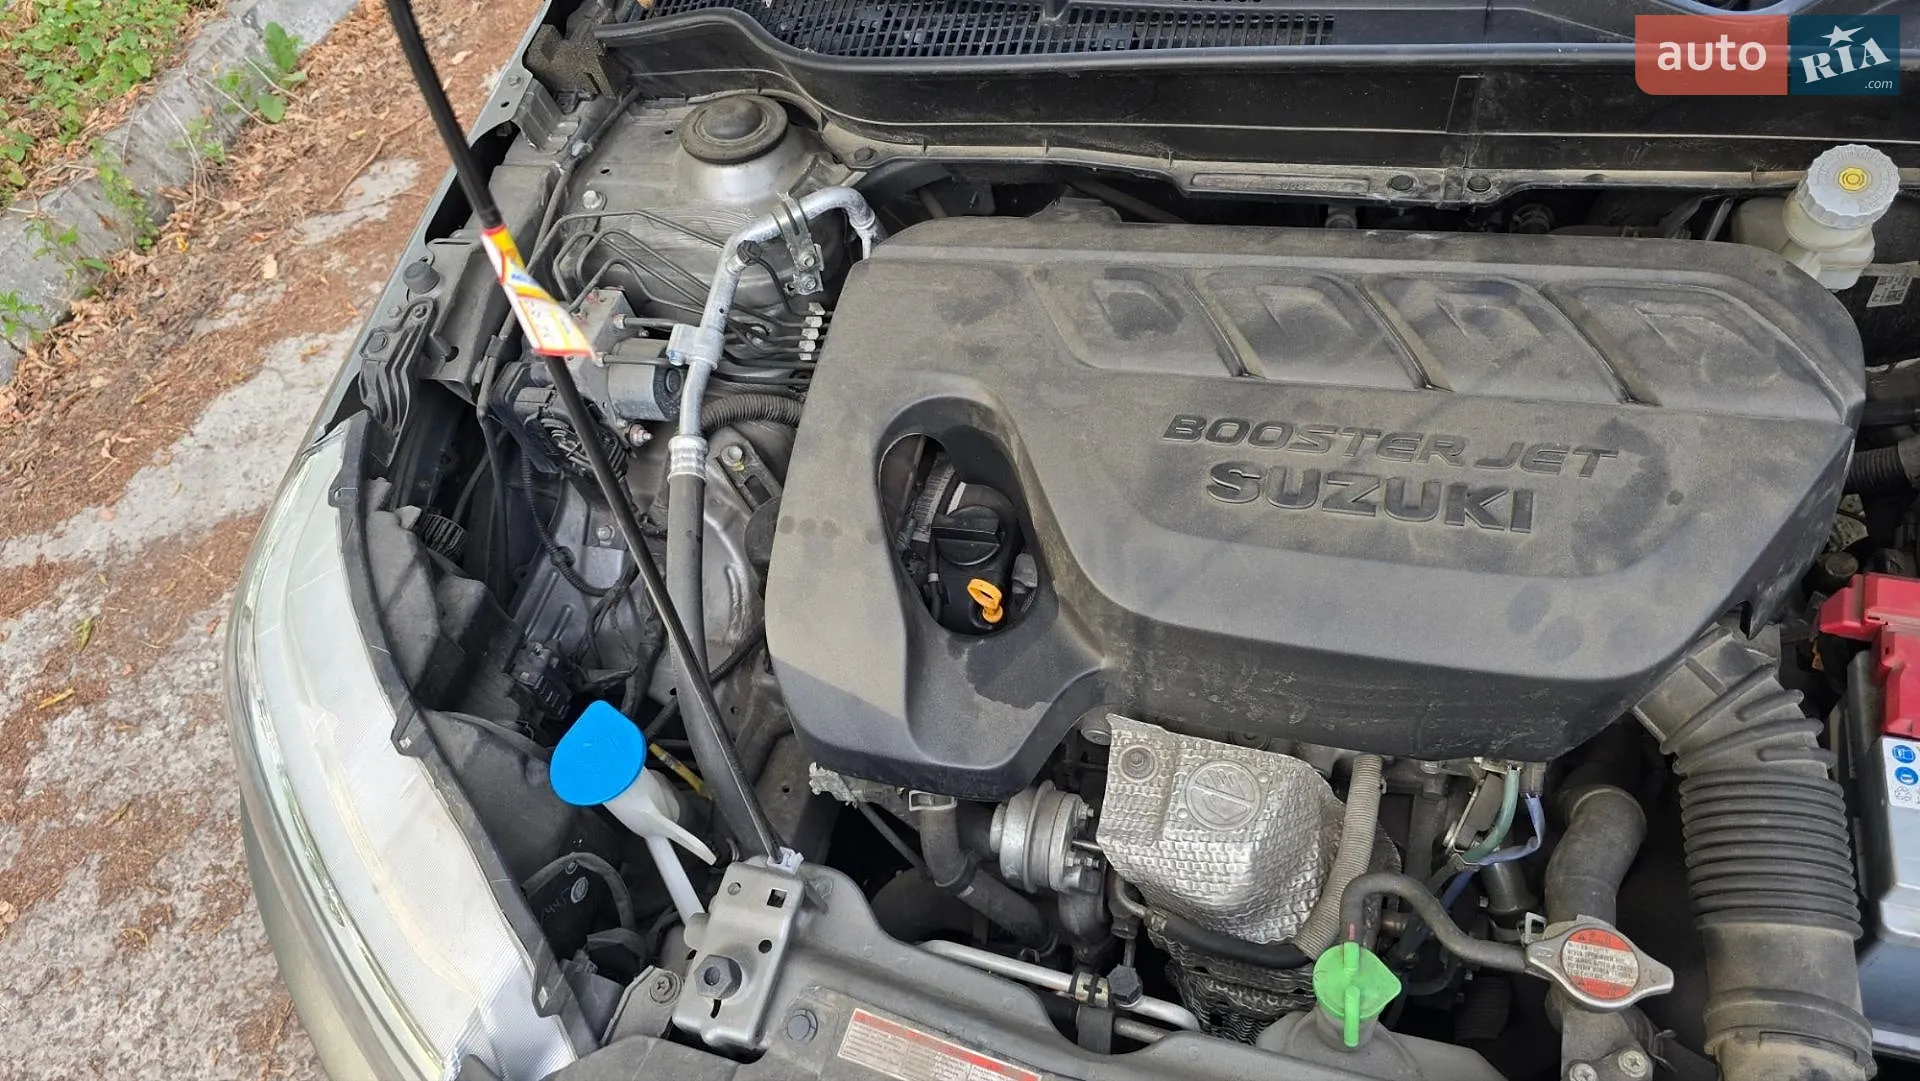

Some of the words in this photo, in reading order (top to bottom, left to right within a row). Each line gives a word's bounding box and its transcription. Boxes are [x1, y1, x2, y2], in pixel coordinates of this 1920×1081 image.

[1162, 413, 1467, 467] BOOSTER
[1475, 441, 1618, 478] JET
[1206, 460, 1534, 534] SUZUKI
